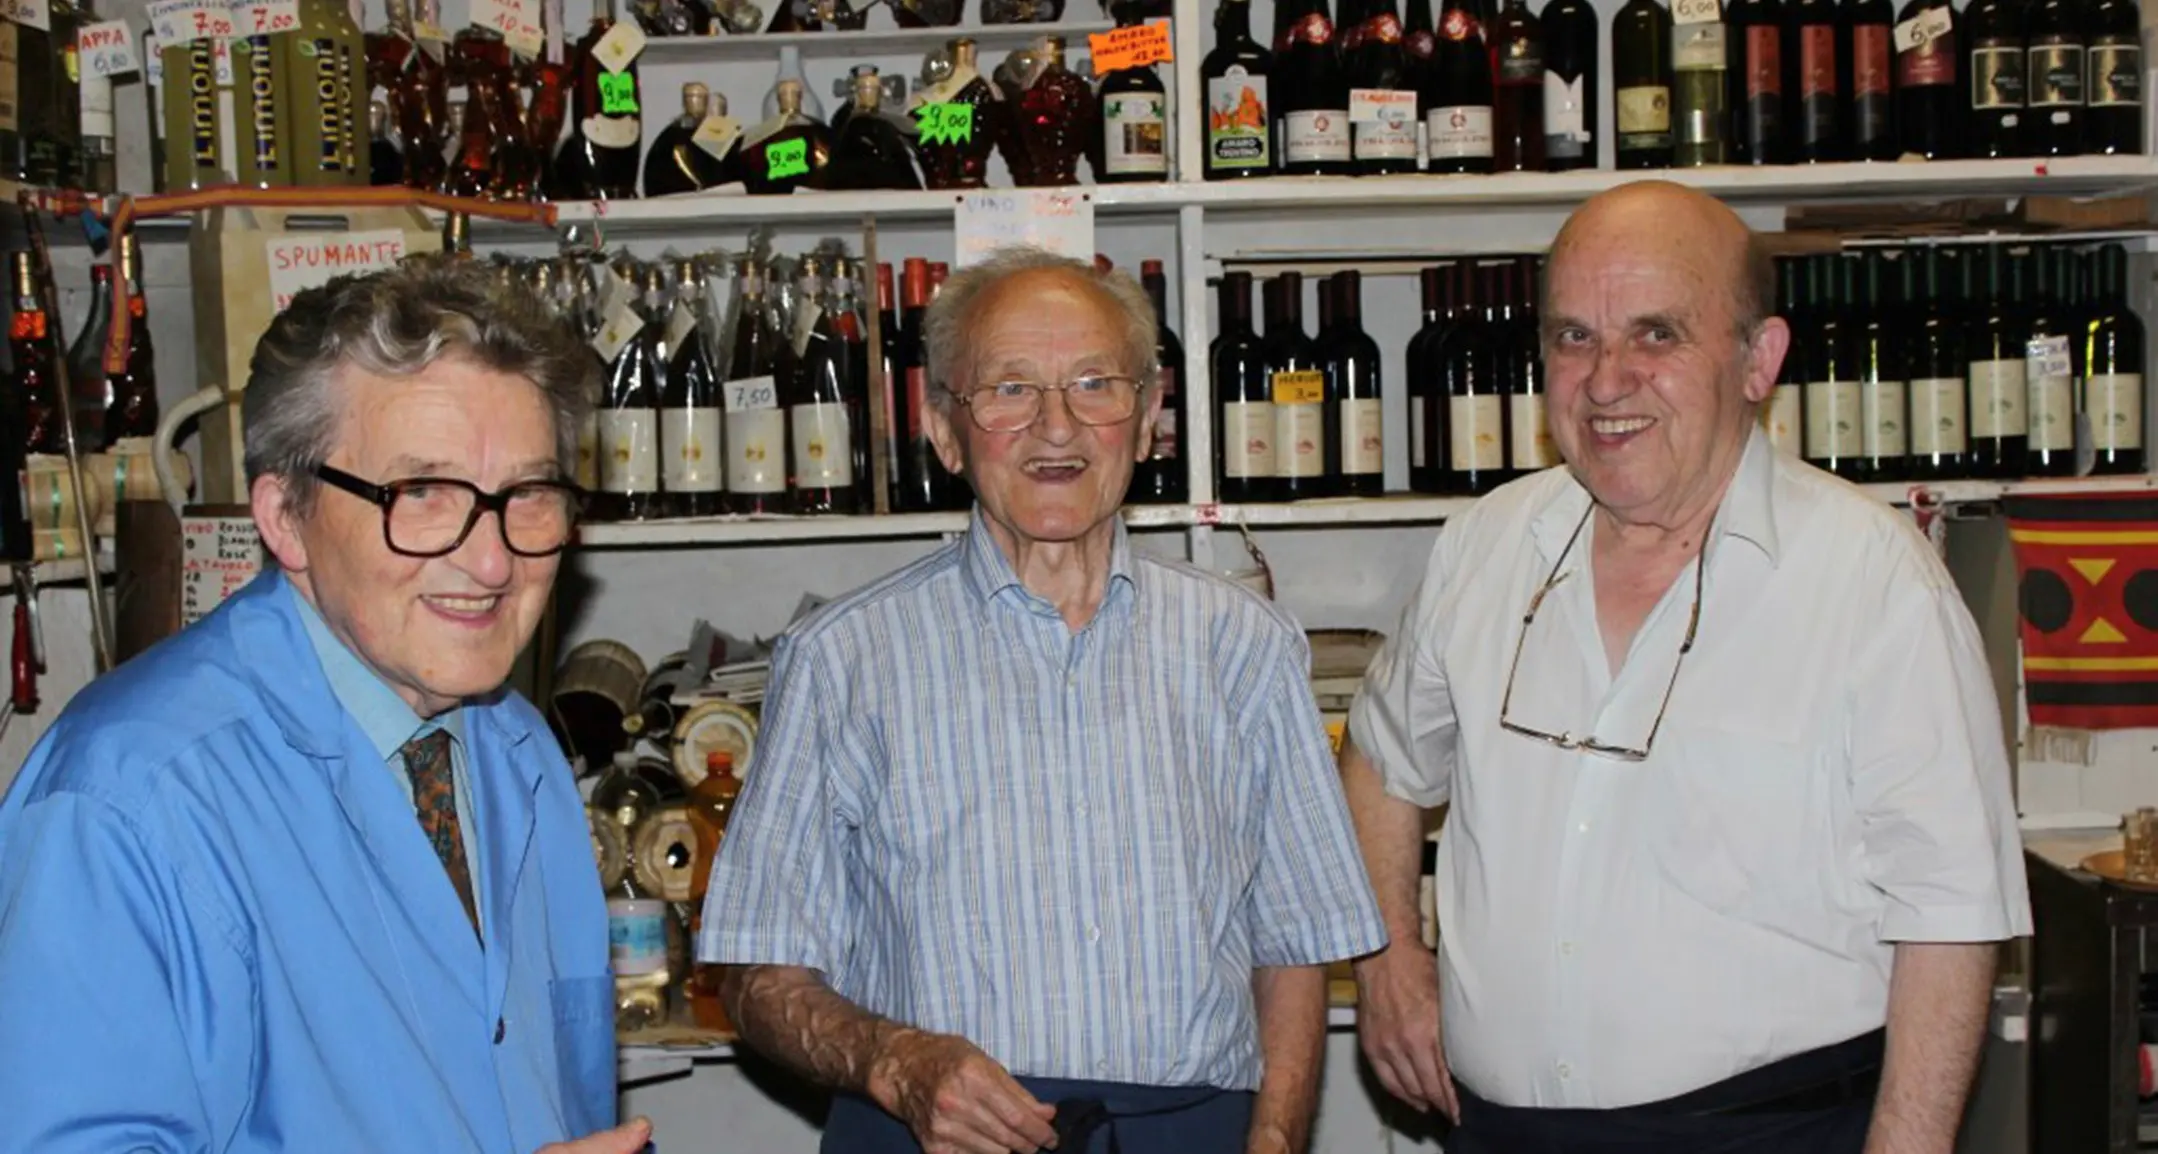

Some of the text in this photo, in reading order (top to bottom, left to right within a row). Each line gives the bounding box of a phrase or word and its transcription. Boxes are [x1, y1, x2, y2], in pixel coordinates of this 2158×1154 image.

[928, 104, 968, 134] 9,00
[274, 241, 400, 270] SPUMANTE
[732, 386, 772, 411] 7,50
